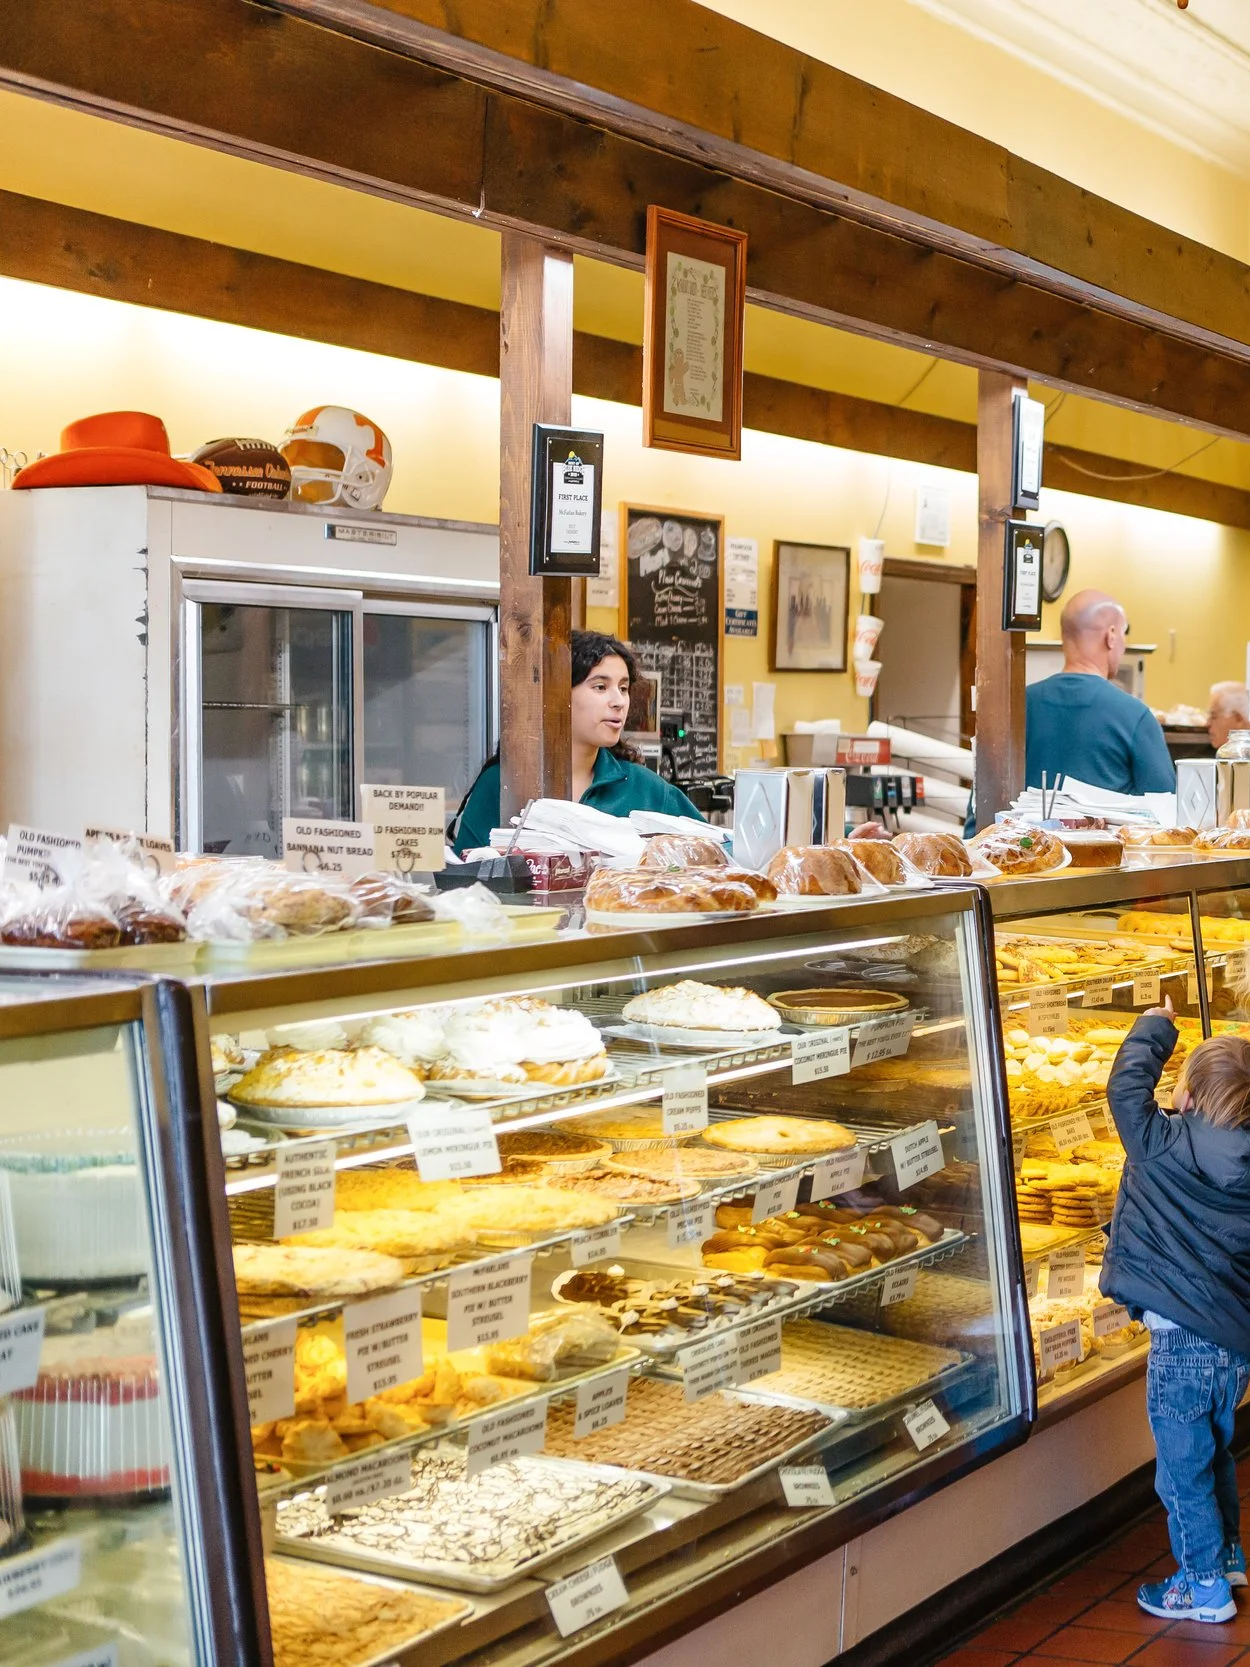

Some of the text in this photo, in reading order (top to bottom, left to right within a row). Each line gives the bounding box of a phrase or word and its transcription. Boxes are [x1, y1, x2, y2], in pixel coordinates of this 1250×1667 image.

[246, 481, 284, 491] FOOTBALL
[373, 790, 438, 800] BACK BY POPULAR
[19, 831, 35, 842] OLD
[296, 826, 361, 838] OLD FASHIONED
[385, 826, 426, 835] FASHIONED
[146, 840, 172, 852] LOAVES
[396, 839, 418, 847] CAKES
[287, 843, 373, 856] BANNANA NUT BREAD
[794, 1054, 815, 1065] COCONUT
[816, 1049, 838, 1060] MERINGUE
[675, 1089, 705, 1099] FASHIONED
[667, 1108, 684, 1116] CREAM
[1058, 1118, 1076, 1127] FASHIONED
[905, 1142, 917, 1153] DUTCH
[284, 1149, 327, 1164] AUTHENTIC
[907, 1154, 920, 1167] BUTTER
[281, 1168, 310, 1179] FRENCH
[308, 1181, 331, 1192] BLACK
[451, 1275, 528, 1299] SOUTHERN BLACKBERRY
[464, 1304, 474, 1313] PIE
[488, 1295, 513, 1308] BUTTER
[472, 1312, 504, 1327] STREUSEL
[346, 1312, 418, 1340] FRESH STRAWBERRY
[740, 1329, 750, 1338] OUR
[750, 1332, 778, 1348] FASHIONED
[357, 1346, 369, 1356] PIE
[367, 1354, 401, 1373] STREUSEL
[482, 1408, 534, 1434] OLD FASHIONED
[468, 1422, 544, 1456] COCONUT MACAROONS
[326, 1466, 359, 1484] ALMOND
[360, 1452, 410, 1474] MACAROONS
